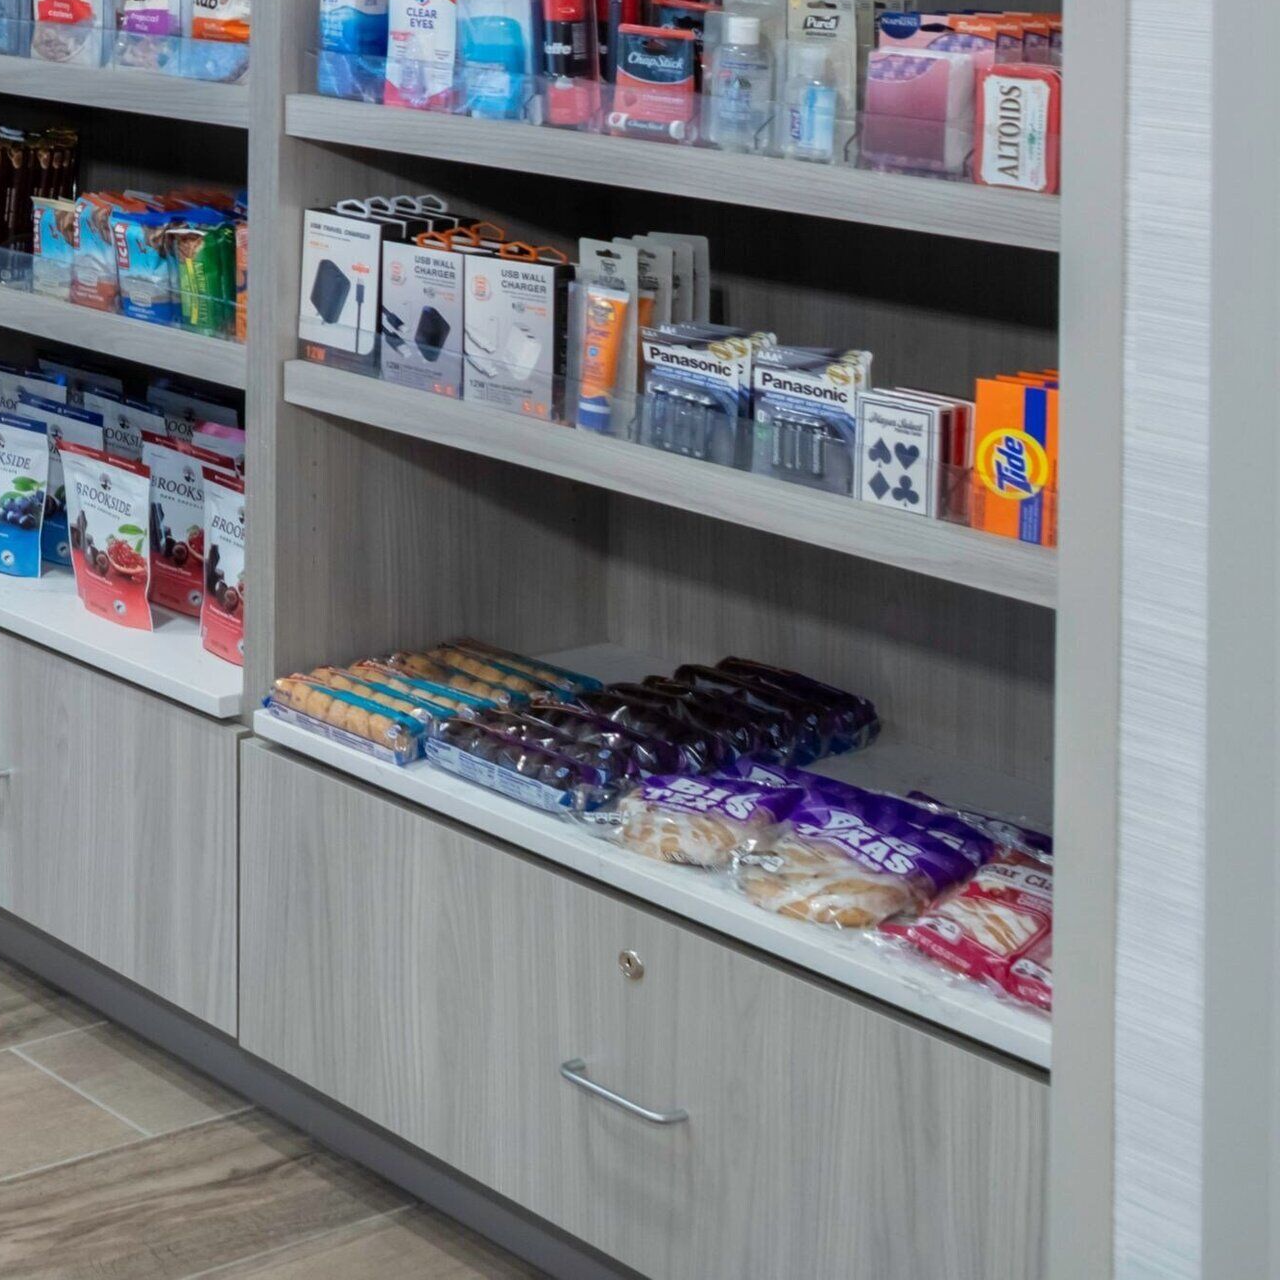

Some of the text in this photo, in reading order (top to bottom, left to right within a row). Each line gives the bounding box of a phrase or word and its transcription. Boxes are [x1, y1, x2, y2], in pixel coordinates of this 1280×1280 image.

[406, 6, 438, 19] CLEAR
[409, 18, 435, 30] EYES
[997, 82, 1022, 180] ALTOIDS
[415, 255, 456, 270] USB WALL
[414, 266, 456, 281] CHARGER
[501, 269, 547, 283] USB WALL
[501, 280, 548, 294] CHARGER
[305, 344, 327, 361] 12W
[649, 345, 734, 377] Panasonic
[761, 372, 849, 404] Panasonic
[995, 433, 1033, 495] Tide
[76, 480, 133, 517] BROOKSIDE
